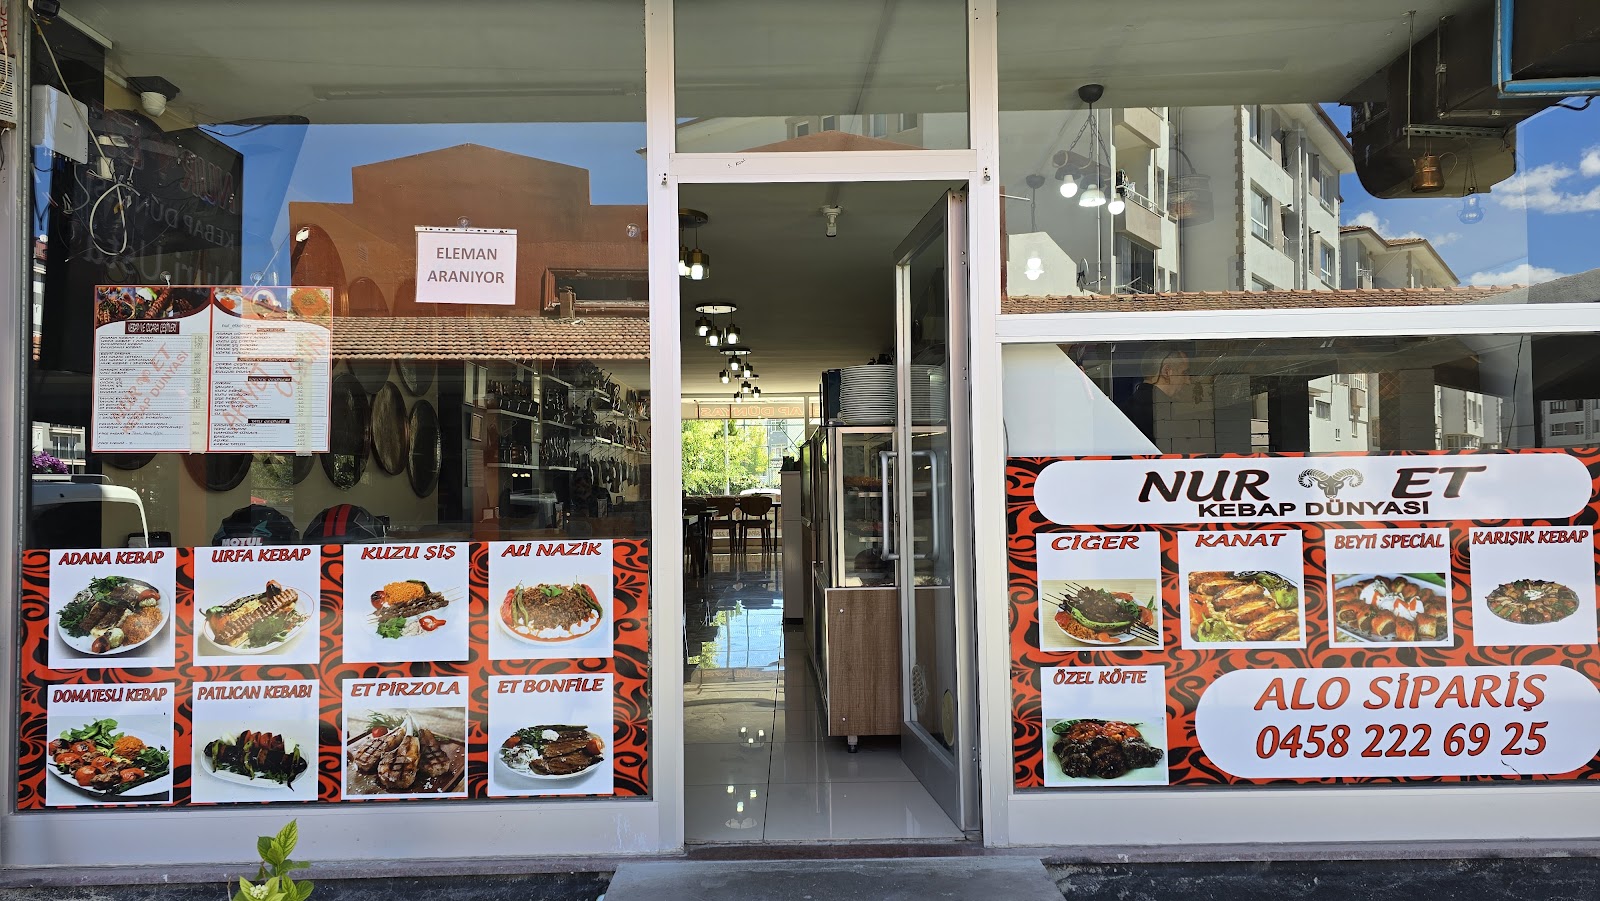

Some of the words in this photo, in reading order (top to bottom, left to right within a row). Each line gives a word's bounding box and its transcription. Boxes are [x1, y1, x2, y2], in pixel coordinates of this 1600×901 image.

[436, 247, 497, 260] ELEMAN
[427, 270, 505, 284] ARANIYOR
[1138, 469, 1271, 503] NUR
[1391, 465, 1487, 499] ET
[1198, 503, 1297, 518] KEBAP
[1305, 498, 1430, 516] DÜNYASI
[221, 537, 263, 546] MOTUL
[1050, 533, 1141, 551] CİĞER
[1194, 532, 1286, 548] KANAT
[1334, 533, 1377, 550] BEYTİ
[1380, 532, 1445, 549] SPECİAL
[1471, 530, 1535, 546] KARIŞIK
[1537, 528, 1589, 544] KEBAP
[211, 549, 254, 563] URFA
[257, 548, 311, 562] KEBAP
[361, 546, 419, 560] KUZU
[423, 544, 457, 561] ŞİŞ
[536, 541, 602, 557] NAZİK
[58, 551, 112, 566] ADANA
[115, 550, 165, 565] KEBAP
[1053, 669, 1095, 685] ÖZEL
[1098, 669, 1148, 685] KÖFTE
[197, 686, 261, 700] PATLICAN
[263, 684, 312, 699] KEBABI
[351, 683, 375, 697] ET
[376, 681, 461, 697] PİRZOLA
[497, 680, 522, 694] ET
[523, 678, 605, 693] BONFİLE
[1253, 676, 1351, 711] ALO
[1363, 672, 1548, 713] SİPARİŞ
[52, 688, 124, 703] DOMATESLİ
[125, 688, 168, 702] KEBAP
[1255, 724, 1351, 760] 0458
[1360, 723, 1432, 758] 222
[1443, 722, 1491, 757] 69
[1500, 721, 1549, 757] 25
